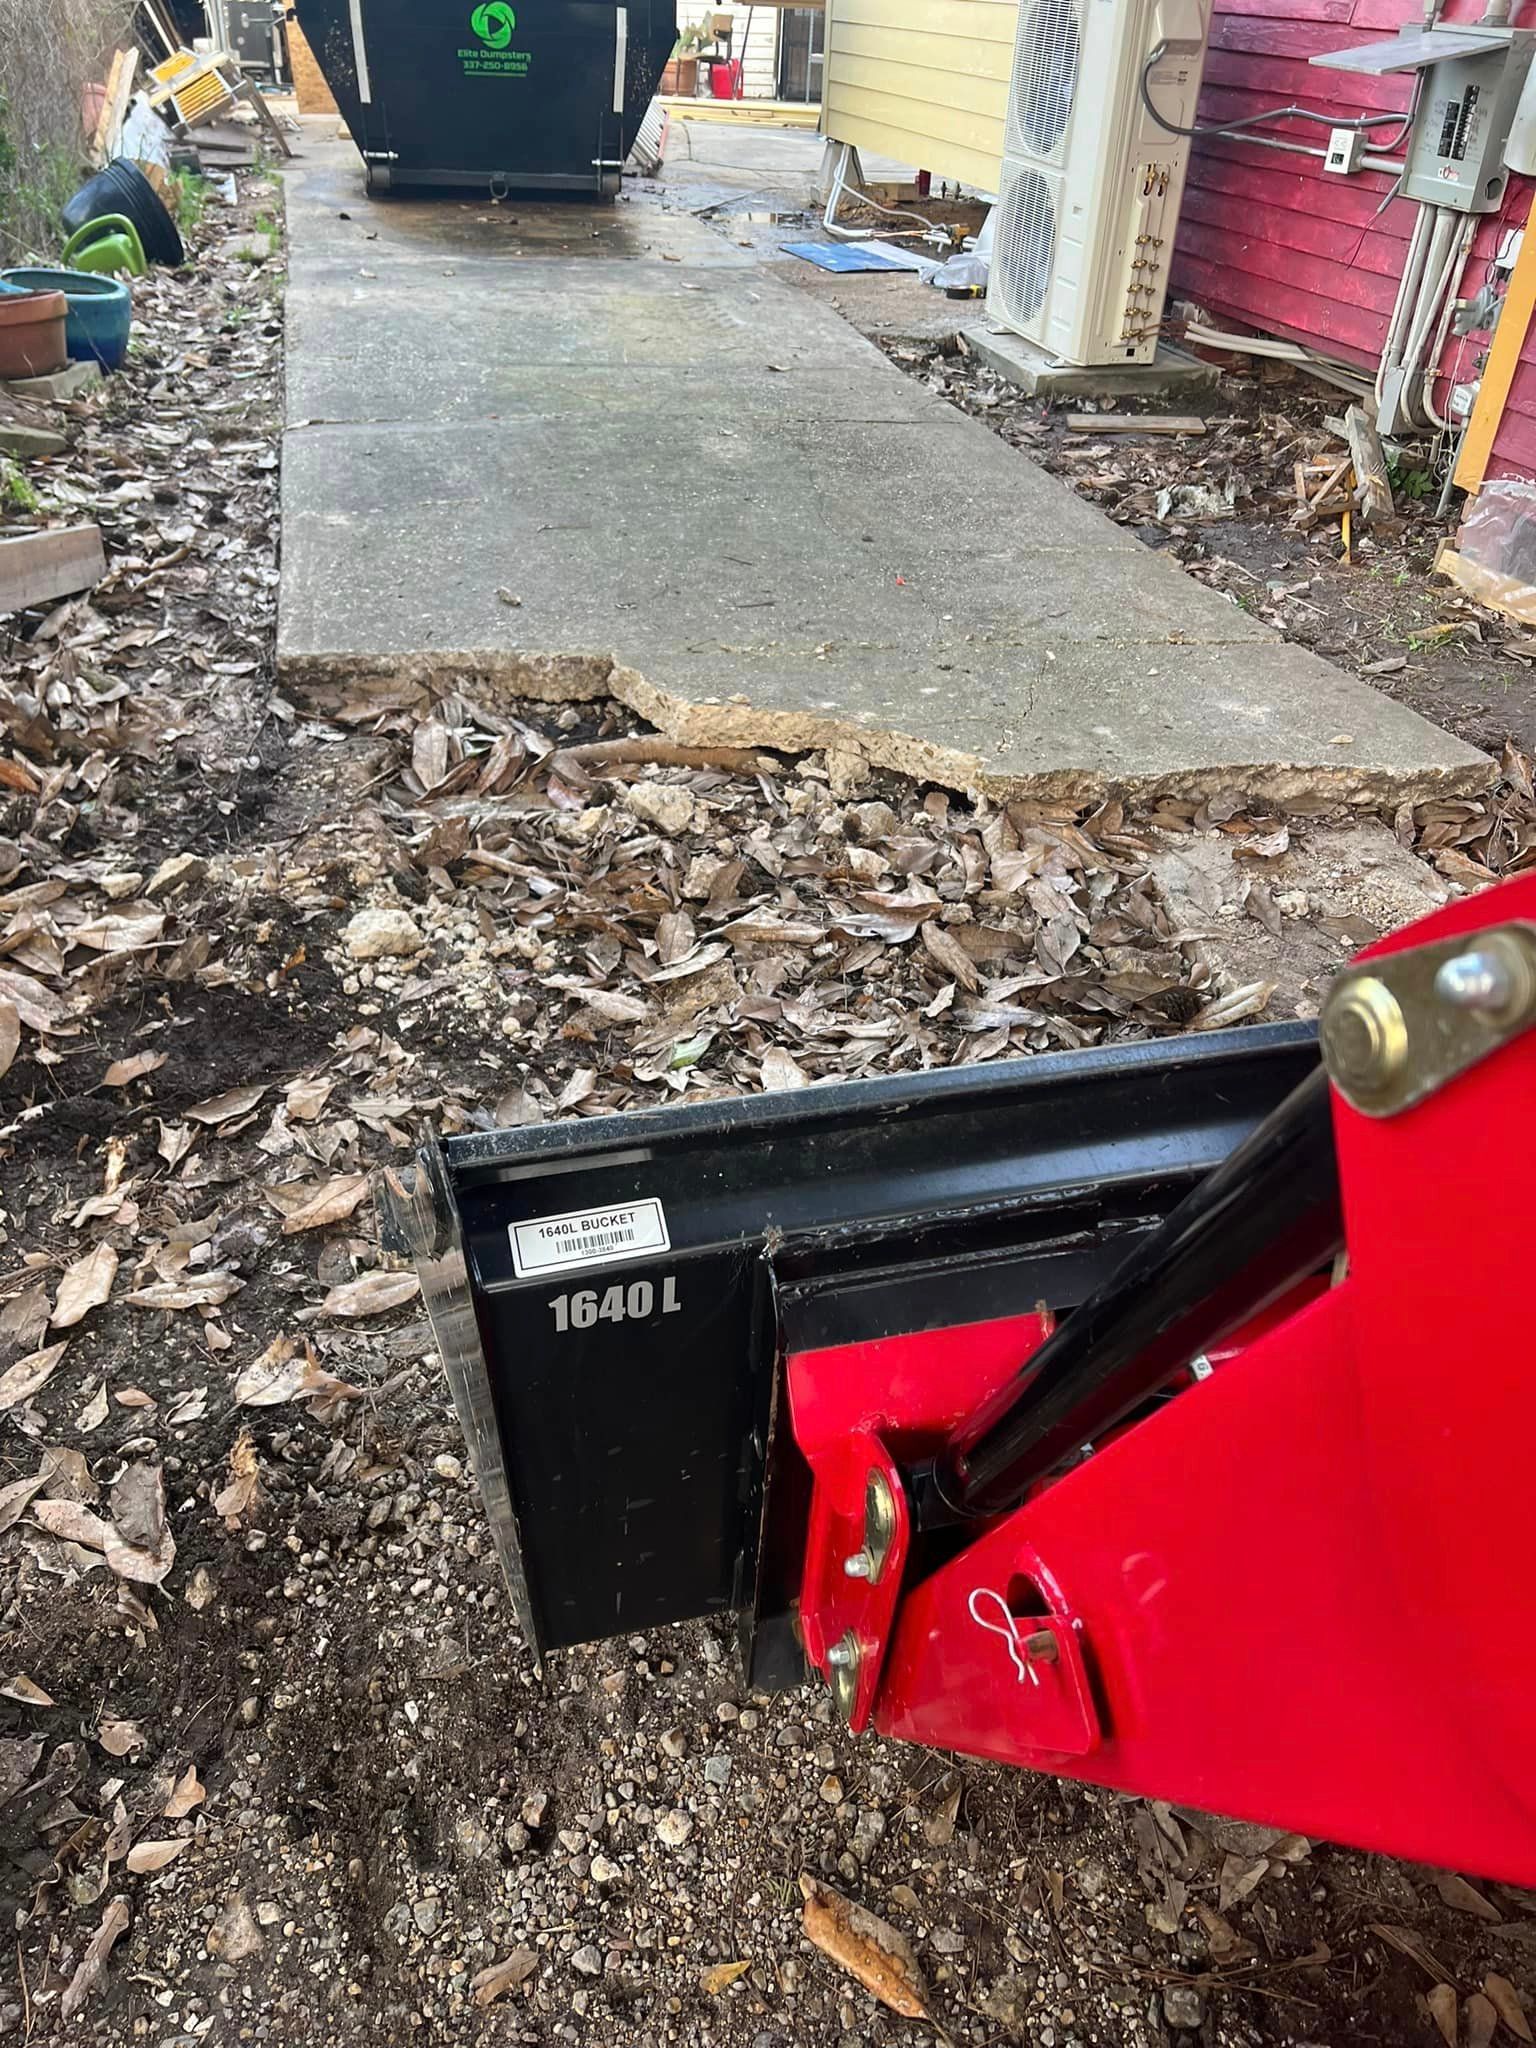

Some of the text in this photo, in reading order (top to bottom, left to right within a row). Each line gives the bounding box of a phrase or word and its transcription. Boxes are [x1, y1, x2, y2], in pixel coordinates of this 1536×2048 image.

[457, 49, 532, 62] Elite Dumpsters
[538, 1212, 636, 1239] 1640L BUCKET
[548, 1276, 682, 1332] 1640 L
